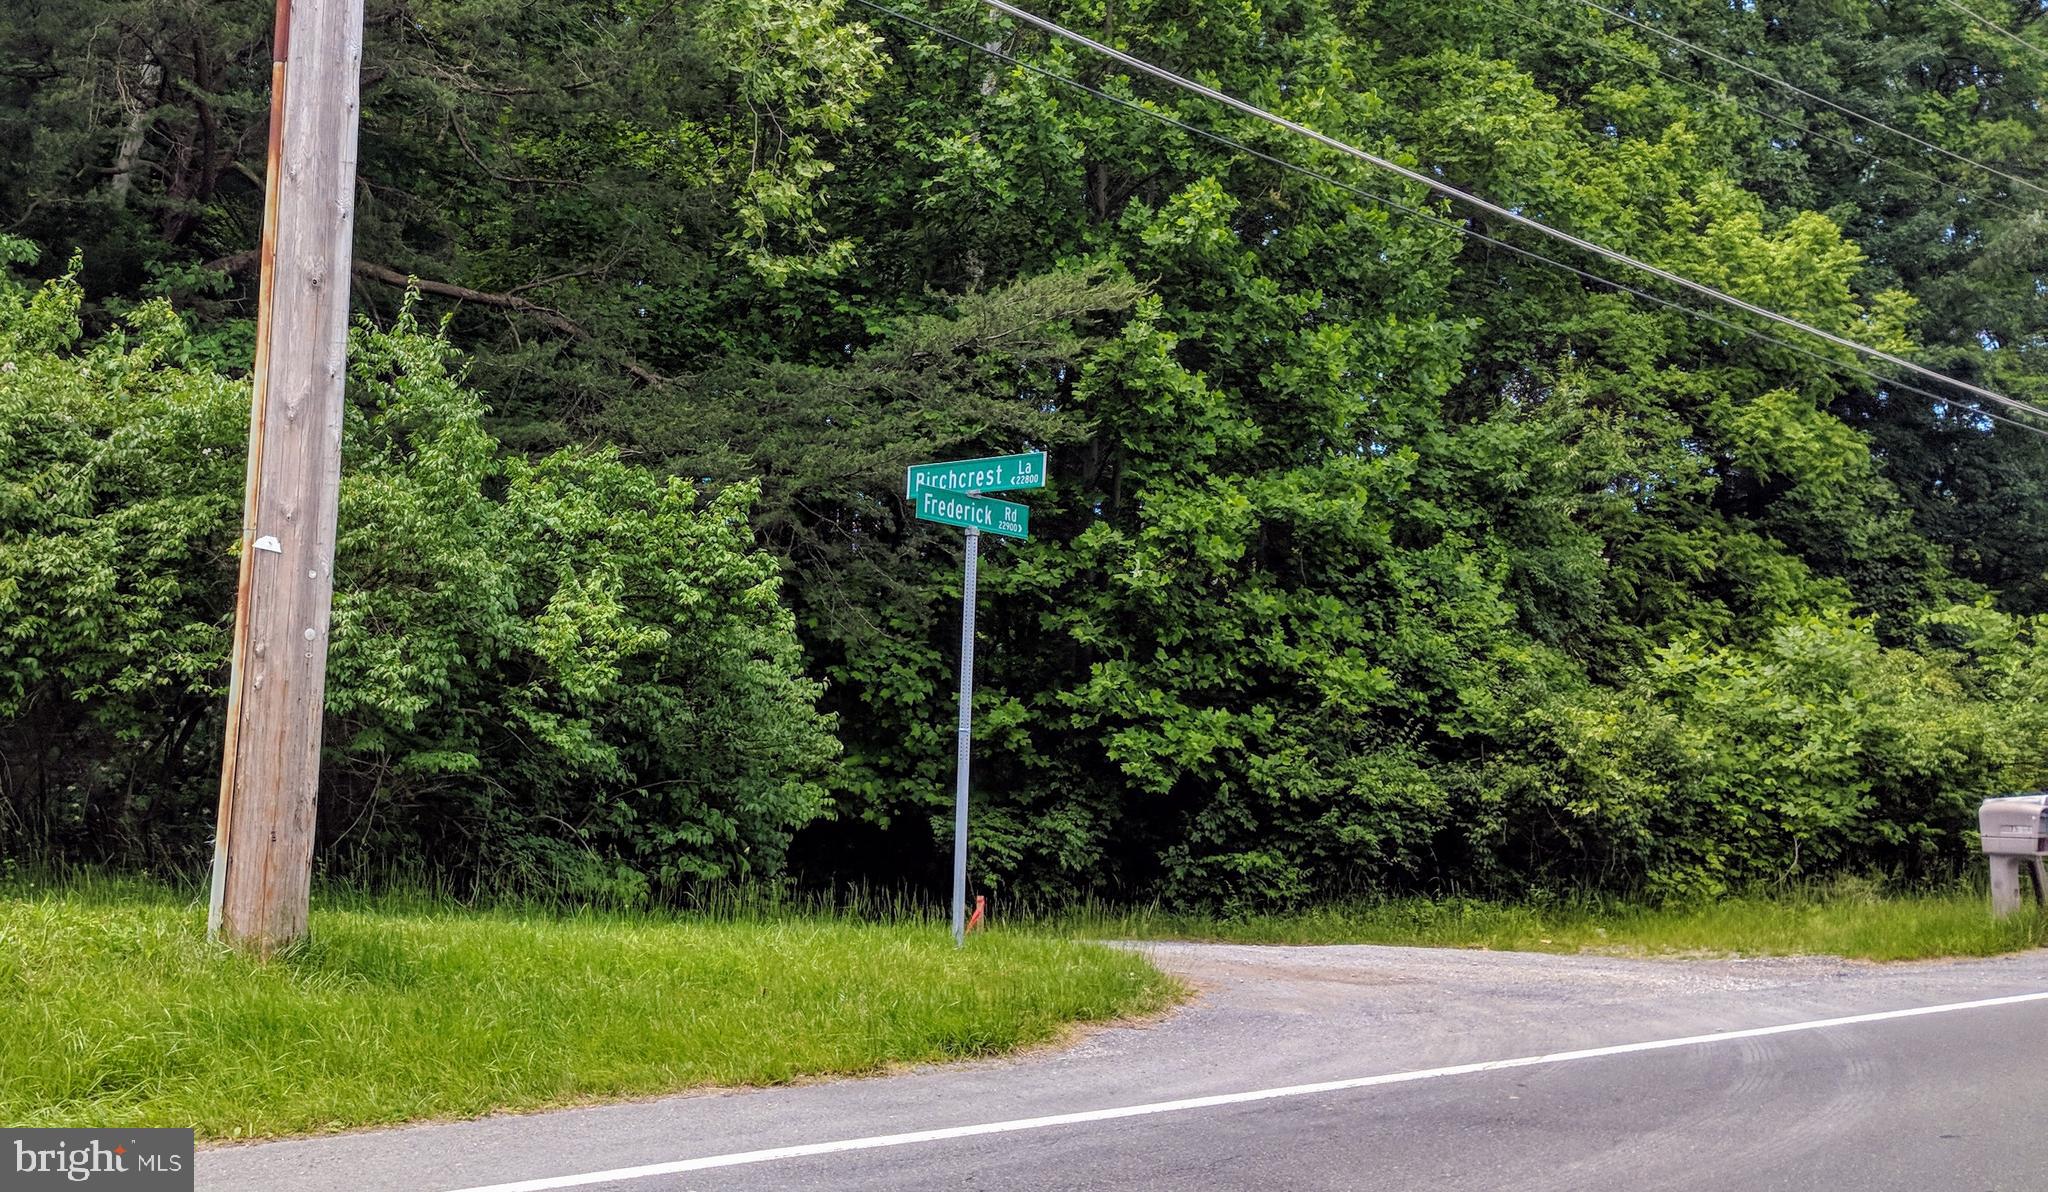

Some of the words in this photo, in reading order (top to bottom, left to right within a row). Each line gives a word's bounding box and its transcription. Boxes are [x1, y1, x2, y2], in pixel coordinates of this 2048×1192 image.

[1018, 460, 1032, 475] La
[1016, 475, 1039, 485] 22800
[924, 492, 992, 525] Frederick
[1004, 506, 1018, 523] Rd
[998, 521, 1018, 532] 22900
